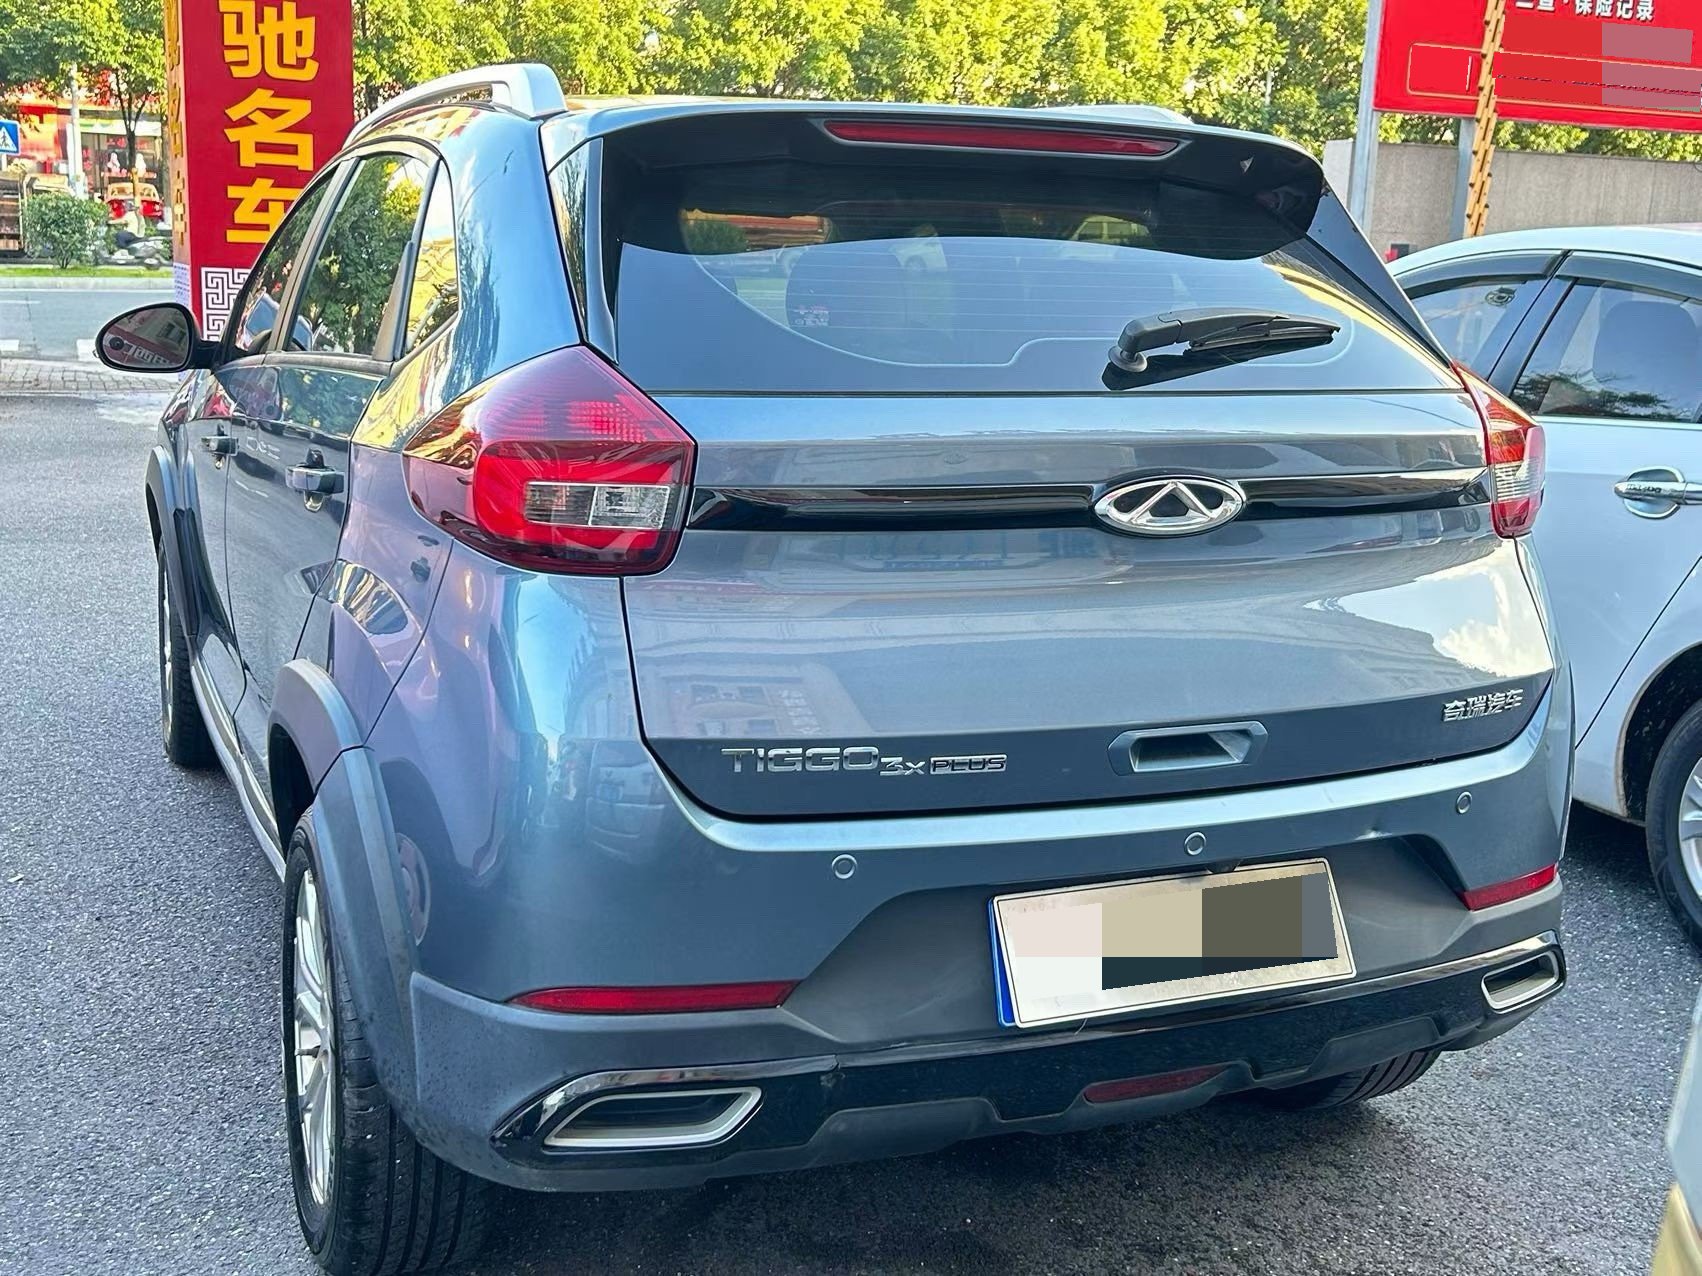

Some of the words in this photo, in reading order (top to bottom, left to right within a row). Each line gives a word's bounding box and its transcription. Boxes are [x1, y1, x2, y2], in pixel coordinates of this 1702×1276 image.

[219, 0, 319, 243] 驰名车
[1443, 689, 1524, 722] 奇瑞汽车
[721, 747, 879, 773] TIGGO
[931, 755, 1007, 775] PLUS
